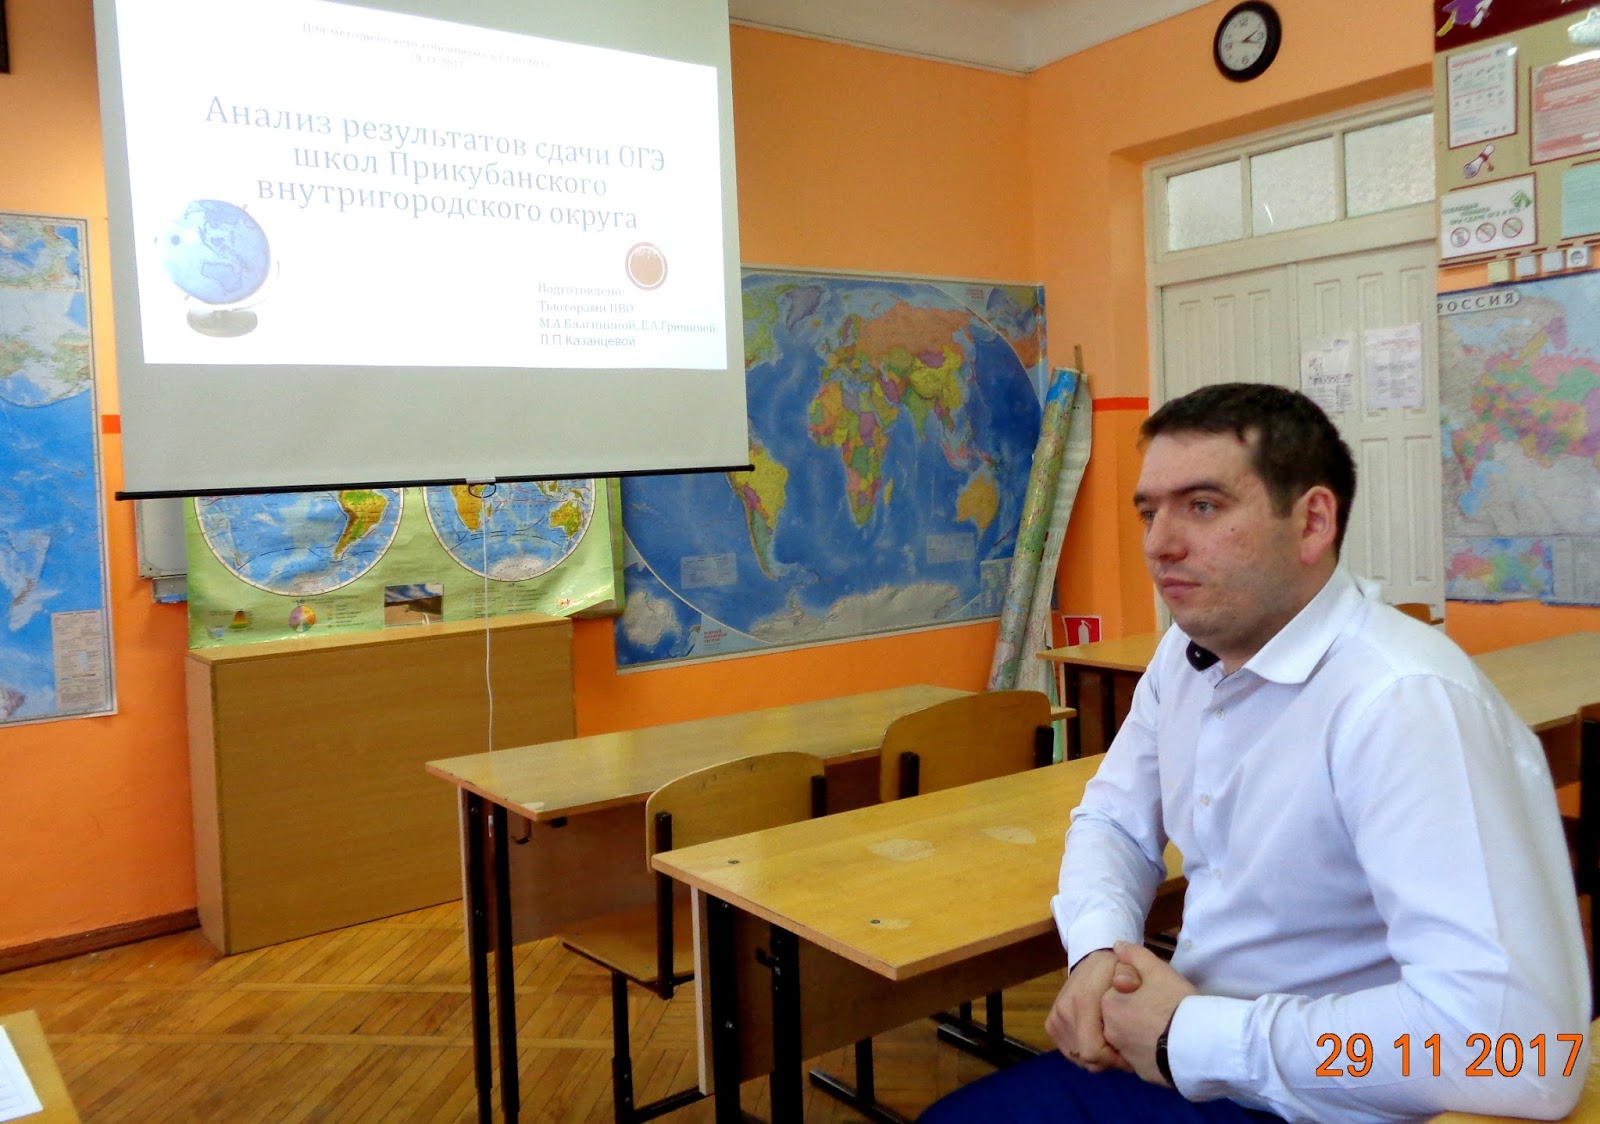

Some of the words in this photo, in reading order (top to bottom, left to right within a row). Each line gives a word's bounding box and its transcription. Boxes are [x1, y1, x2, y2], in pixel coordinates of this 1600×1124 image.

[206, 96, 331, 135] Анализ
[342, 118, 527, 156] результатов
[535, 142, 612, 166] сдачи
[619, 145, 665, 172] ОГЭ
[294, 148, 379, 175] школ
[389, 151, 607, 196] Прикубанского
[257, 180, 541, 222] внутригородского
[550, 206, 638, 233] округа
[538, 282, 625, 297] Подготовлено:
[1437, 292, 1514, 314] РОССИЯ
[538, 301, 607, 315] Тьюторами
